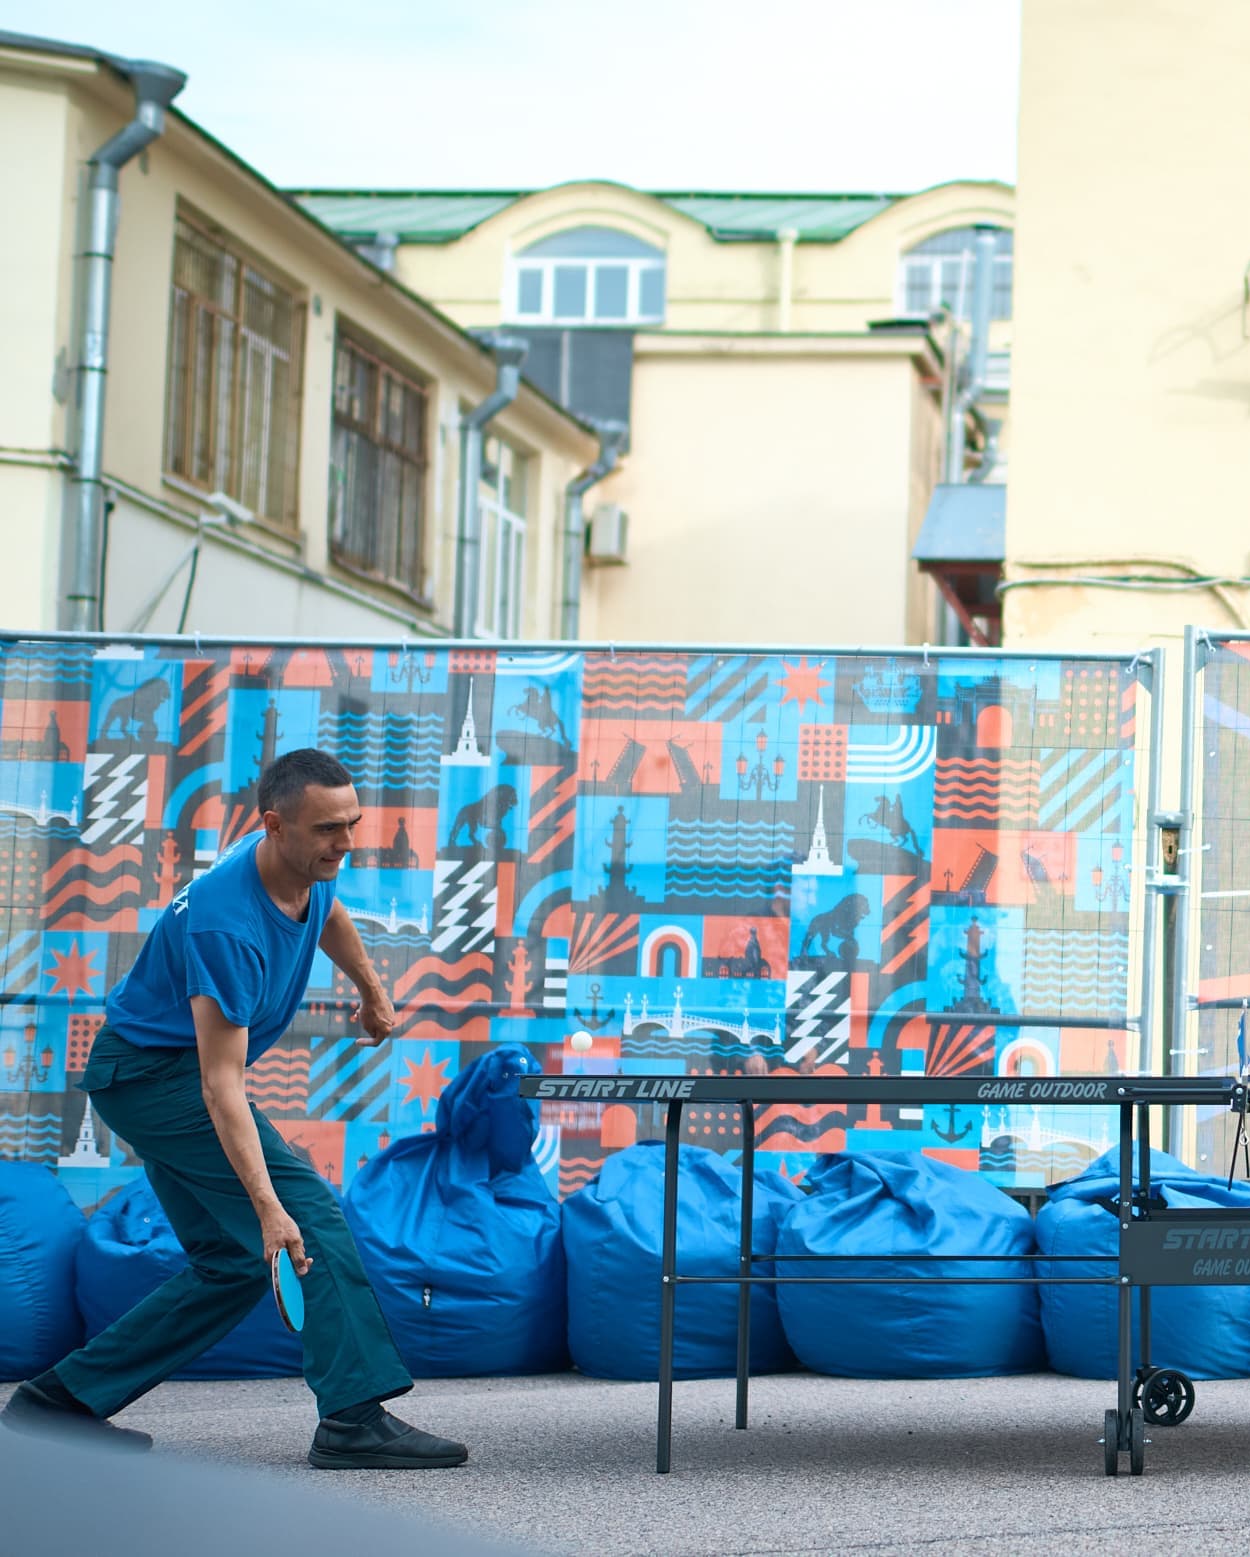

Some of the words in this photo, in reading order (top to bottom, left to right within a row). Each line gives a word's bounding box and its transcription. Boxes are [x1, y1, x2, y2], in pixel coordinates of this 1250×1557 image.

[536, 1080, 634, 1098] START
[636, 1080, 696, 1098] LINE
[978, 1082, 1025, 1098] GAME
[1030, 1082, 1107, 1099] OUTDOOR
[1193, 1258, 1231, 1276] GAME
